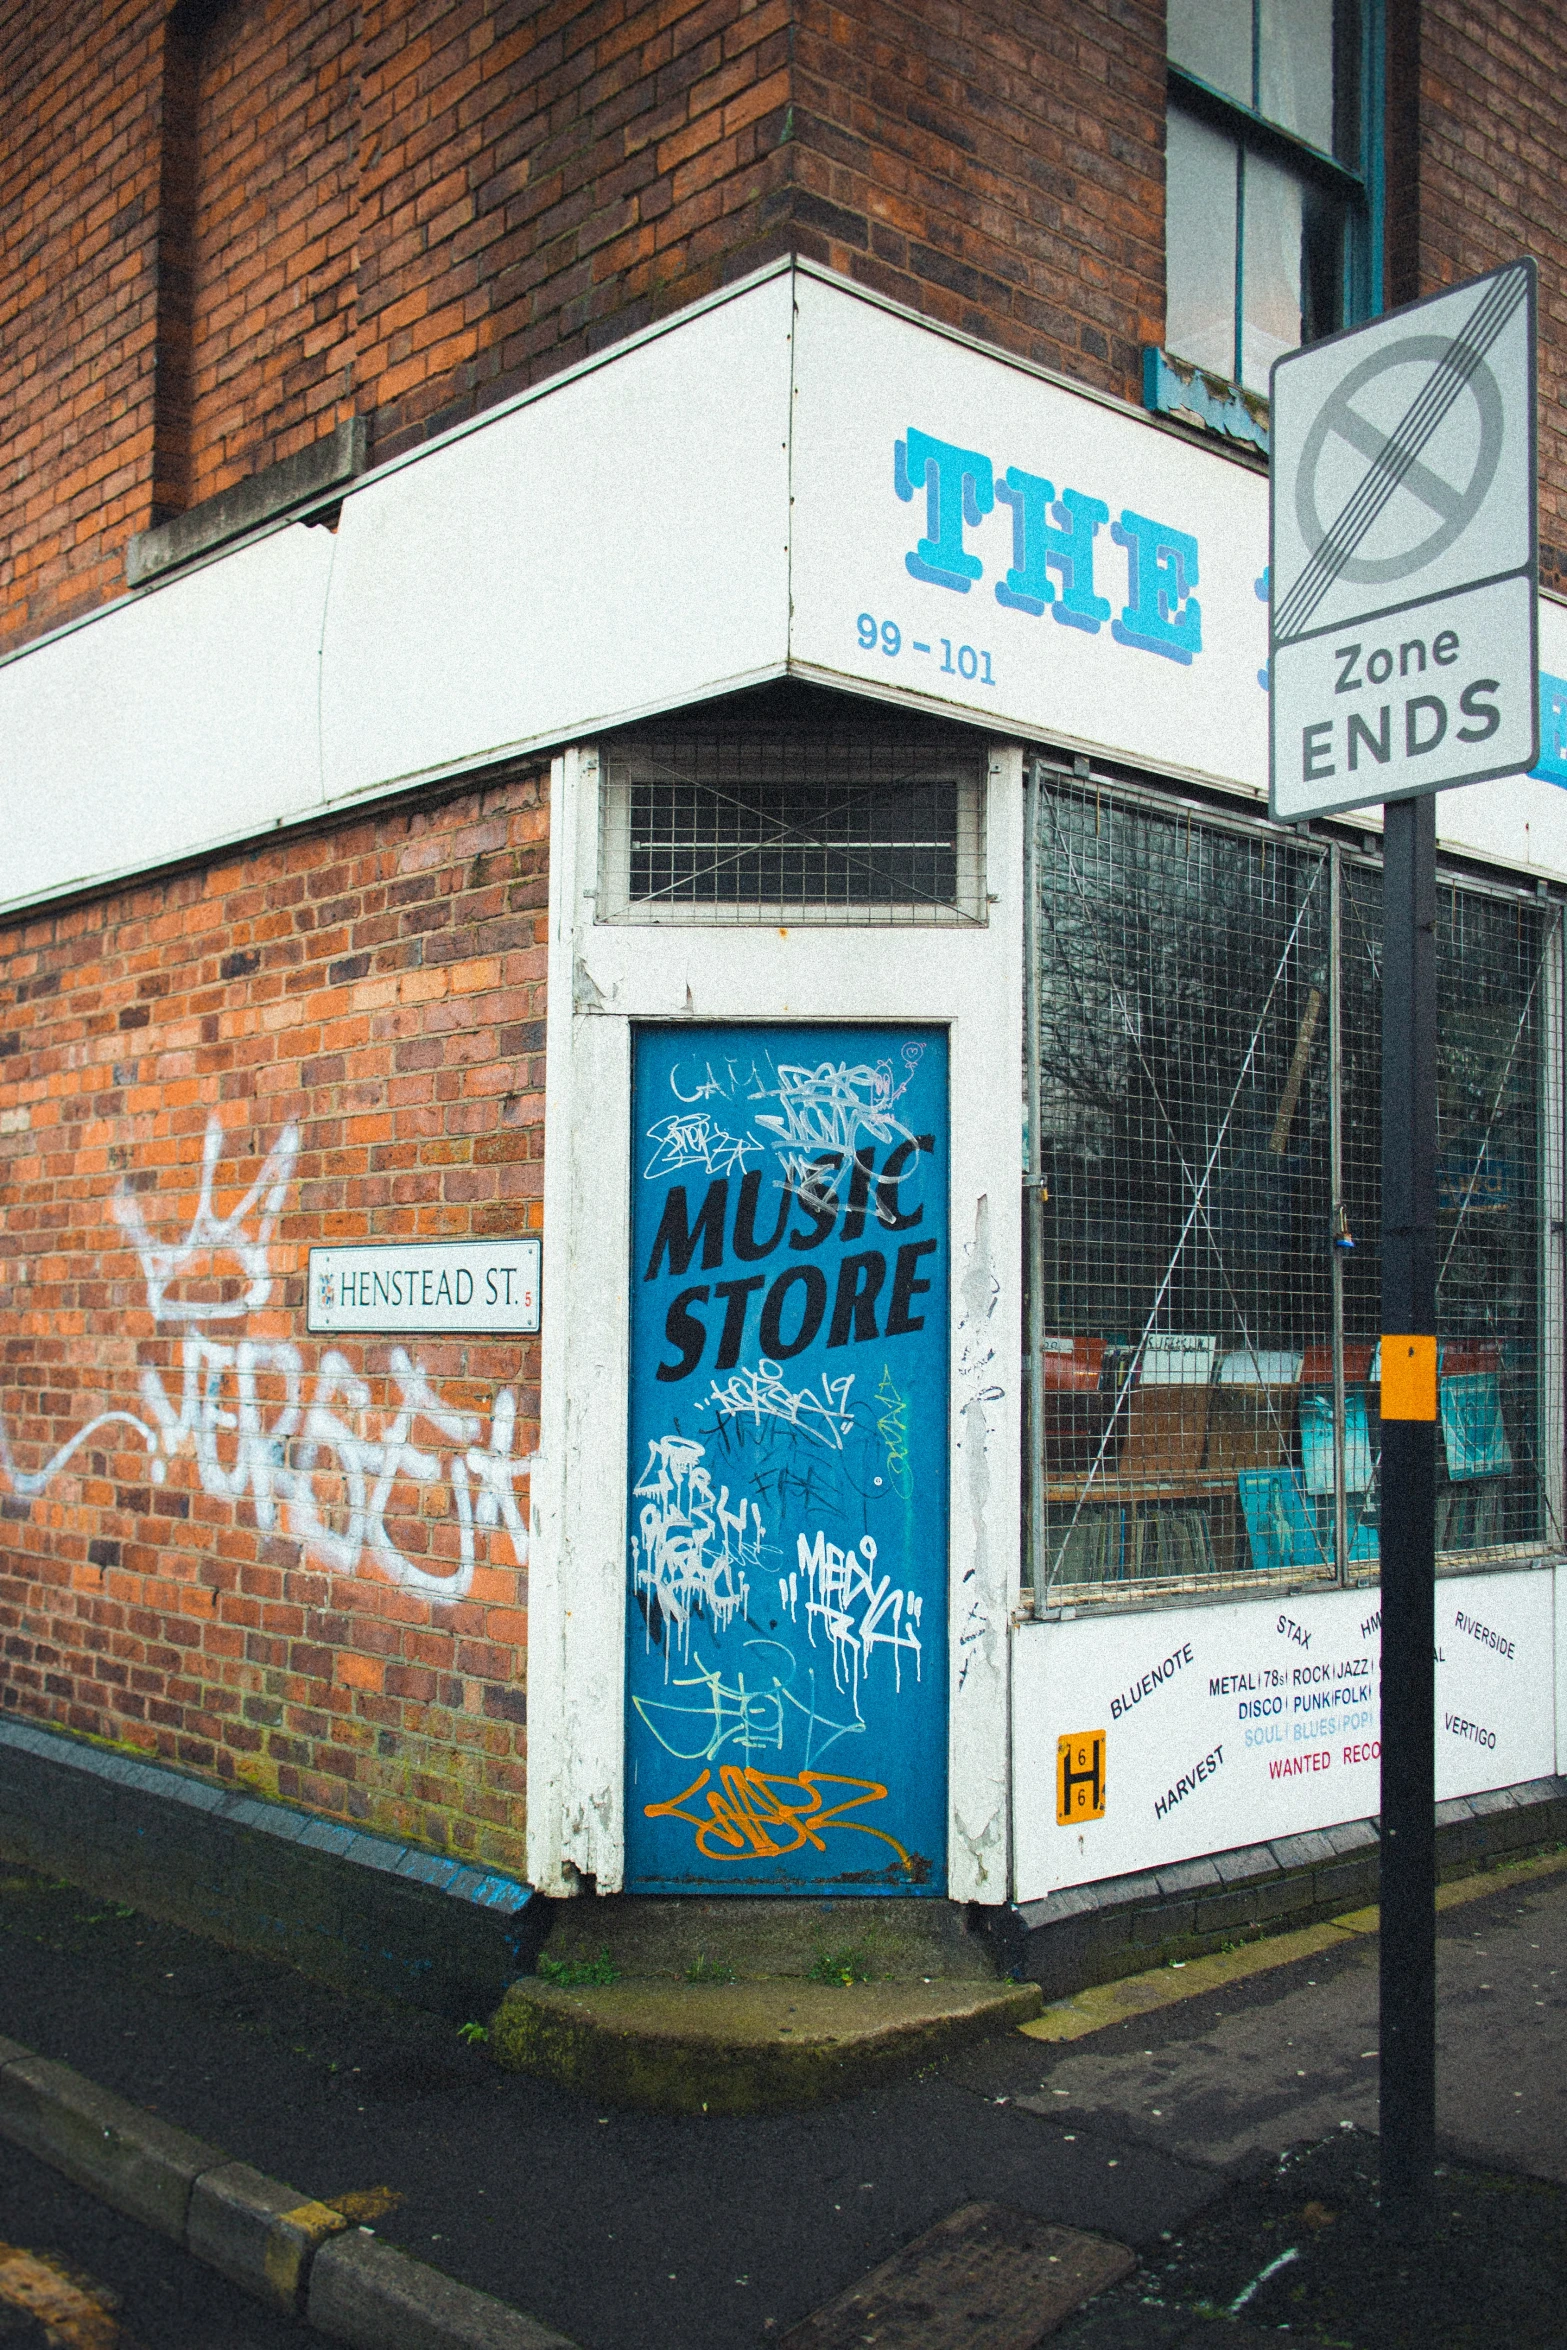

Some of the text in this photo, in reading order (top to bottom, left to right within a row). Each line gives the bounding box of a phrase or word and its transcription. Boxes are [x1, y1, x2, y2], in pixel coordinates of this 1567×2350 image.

[894, 427, 1202, 666] THE
[1334, 630, 1461, 694] Zone
[1302, 678, 1501, 782] ENDS
[644, 1134, 936, 1282] MUSIC
[340, 1267, 532, 1307] HENSTEAD ST. 5
[656, 1238, 937, 1383] STORE
[1276, 1614, 1312, 1649] STAX
[1455, 1610, 1515, 1660] RIVERSIDE
[1110, 1642, 1194, 1720] BLUENOTE
[1209, 1658, 1369, 1697] METAL 78s ROCK JAZZ
[1238, 1685, 1368, 1720] DISCO PUNK FOLK
[1244, 1711, 1369, 1748] SOUL BLUES POP
[1445, 1711, 1496, 1750] VERTIGO
[1077, 1748, 1086, 1766] 6
[1269, 1741, 1382, 1780] WANTED RECO
[1077, 1788, 1086, 1806] 6
[1154, 1744, 1224, 1820] HARVEST
